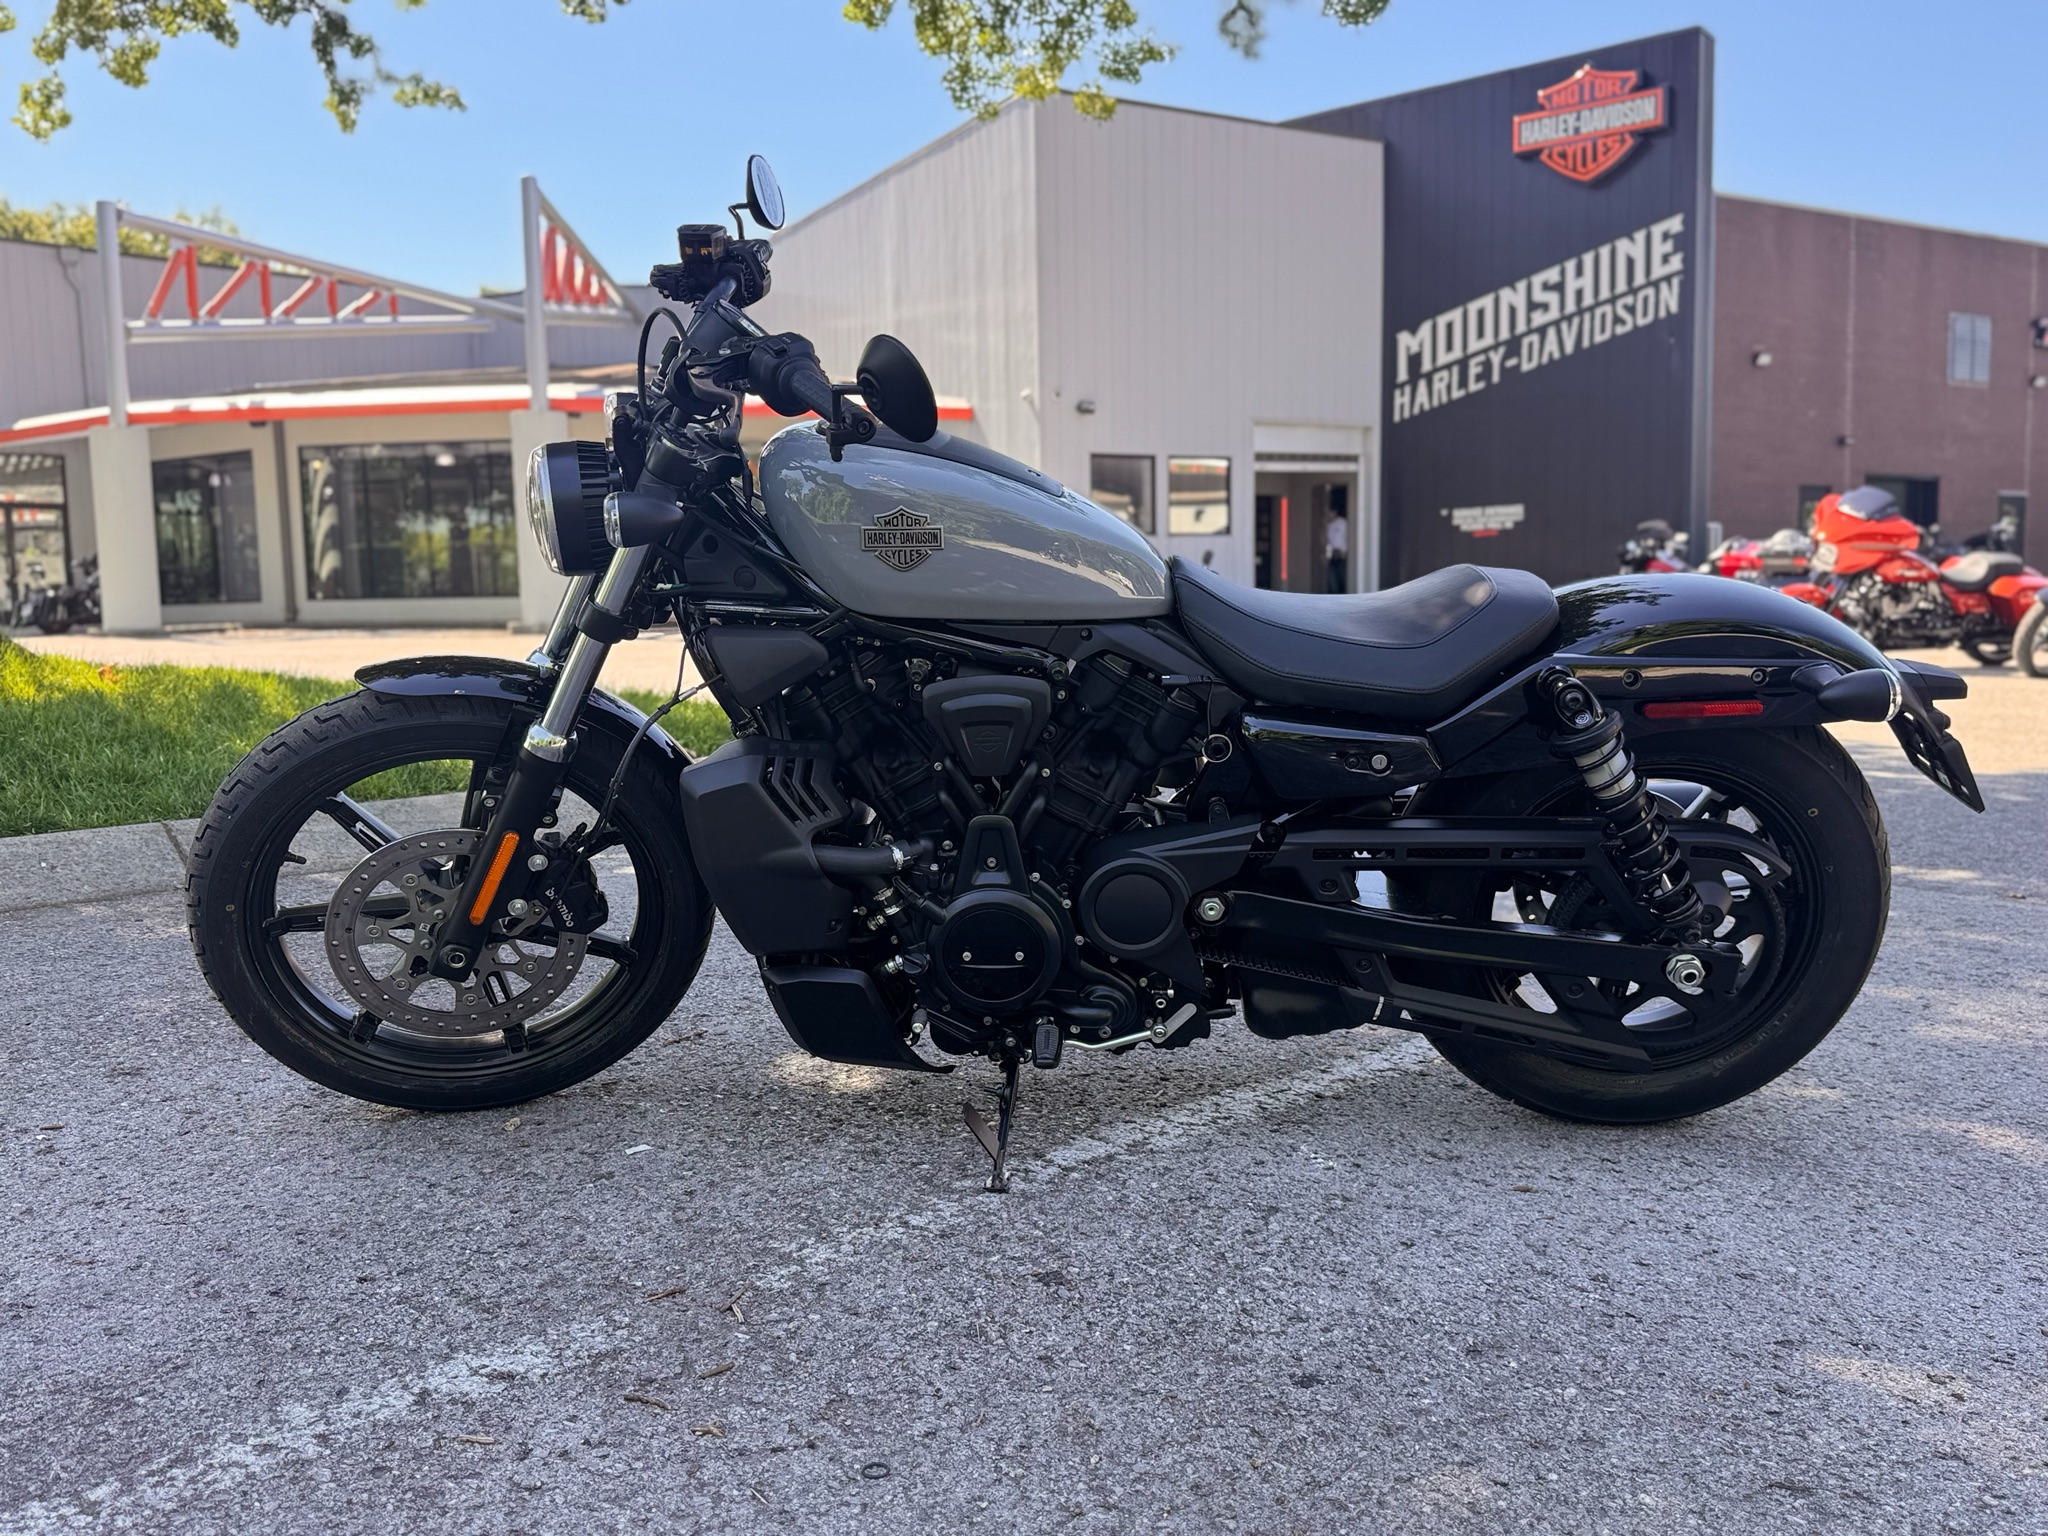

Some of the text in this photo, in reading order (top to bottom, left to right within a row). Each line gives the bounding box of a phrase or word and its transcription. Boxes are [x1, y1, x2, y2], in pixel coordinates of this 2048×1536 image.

[1551, 77, 1622, 106] MOTOR
[1520, 94, 1656, 146] HARLEY-DAVIDSON
[1551, 134, 1621, 170] CYCLES
[1395, 212, 1685, 384] MOONSHINE
[1393, 274, 1683, 424] HARLEY-DAVIDSON
[884, 512, 921, 527] MOTOR
[867, 531, 939, 545] HARLEY-DAVIDSON
[885, 549, 922, 566] CYCLES
